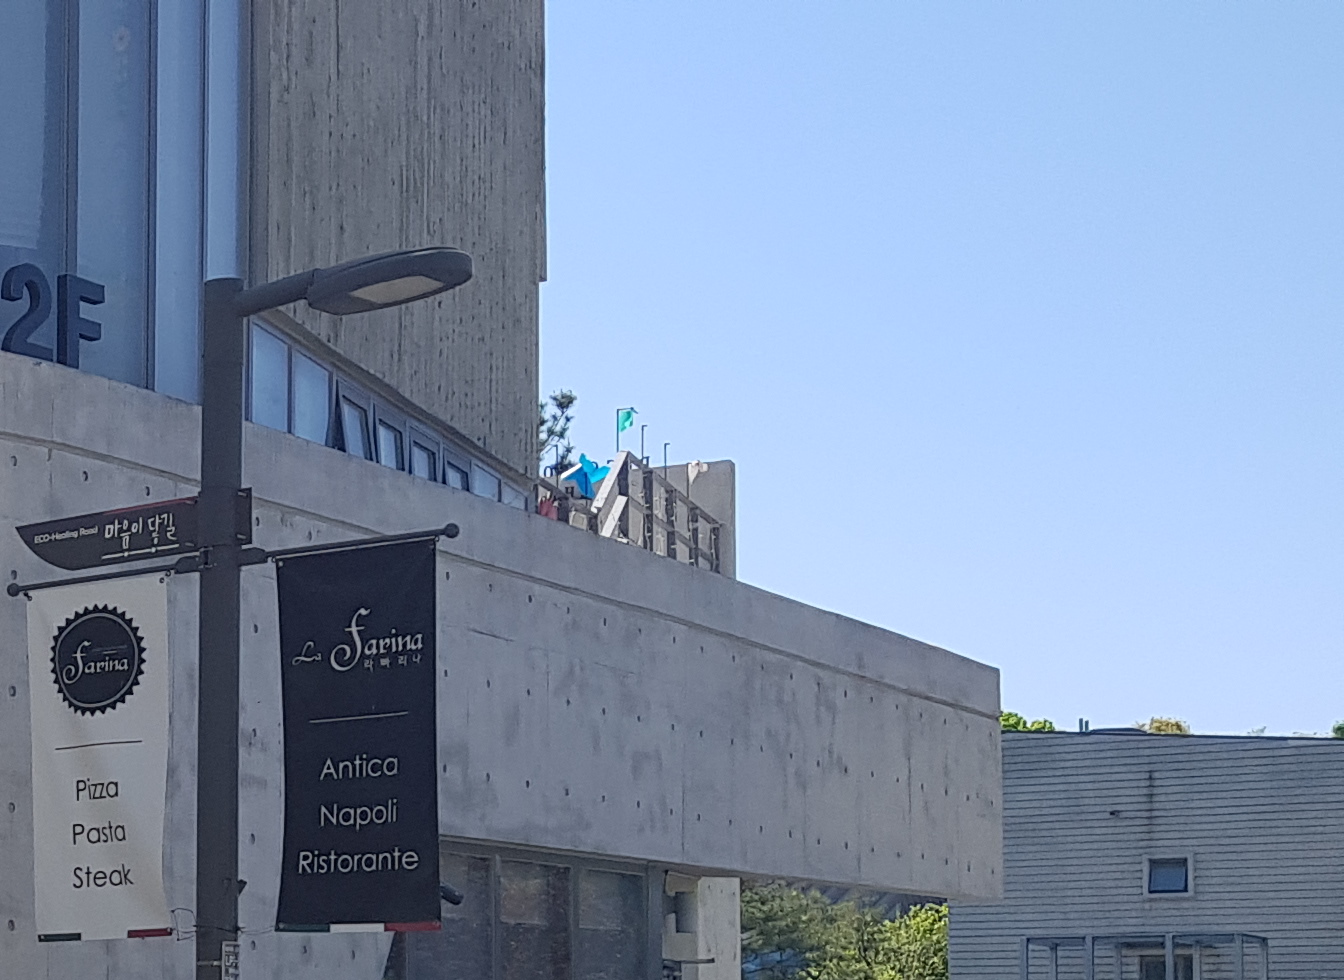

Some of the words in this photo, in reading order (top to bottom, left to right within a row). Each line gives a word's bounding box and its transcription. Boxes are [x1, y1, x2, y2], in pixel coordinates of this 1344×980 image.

[0, 263, 105, 369] 2F
[104, 517, 143, 549] 마음이
[292, 641, 322, 666] La
[320, 754, 399, 782] Antica
[75, 777, 119, 802] Pizza
[319, 799, 398, 832] Napoli
[72, 821, 127, 846] Pasta
[297, 847, 420, 874] Ristorante
[72, 865, 135, 889] Steak
